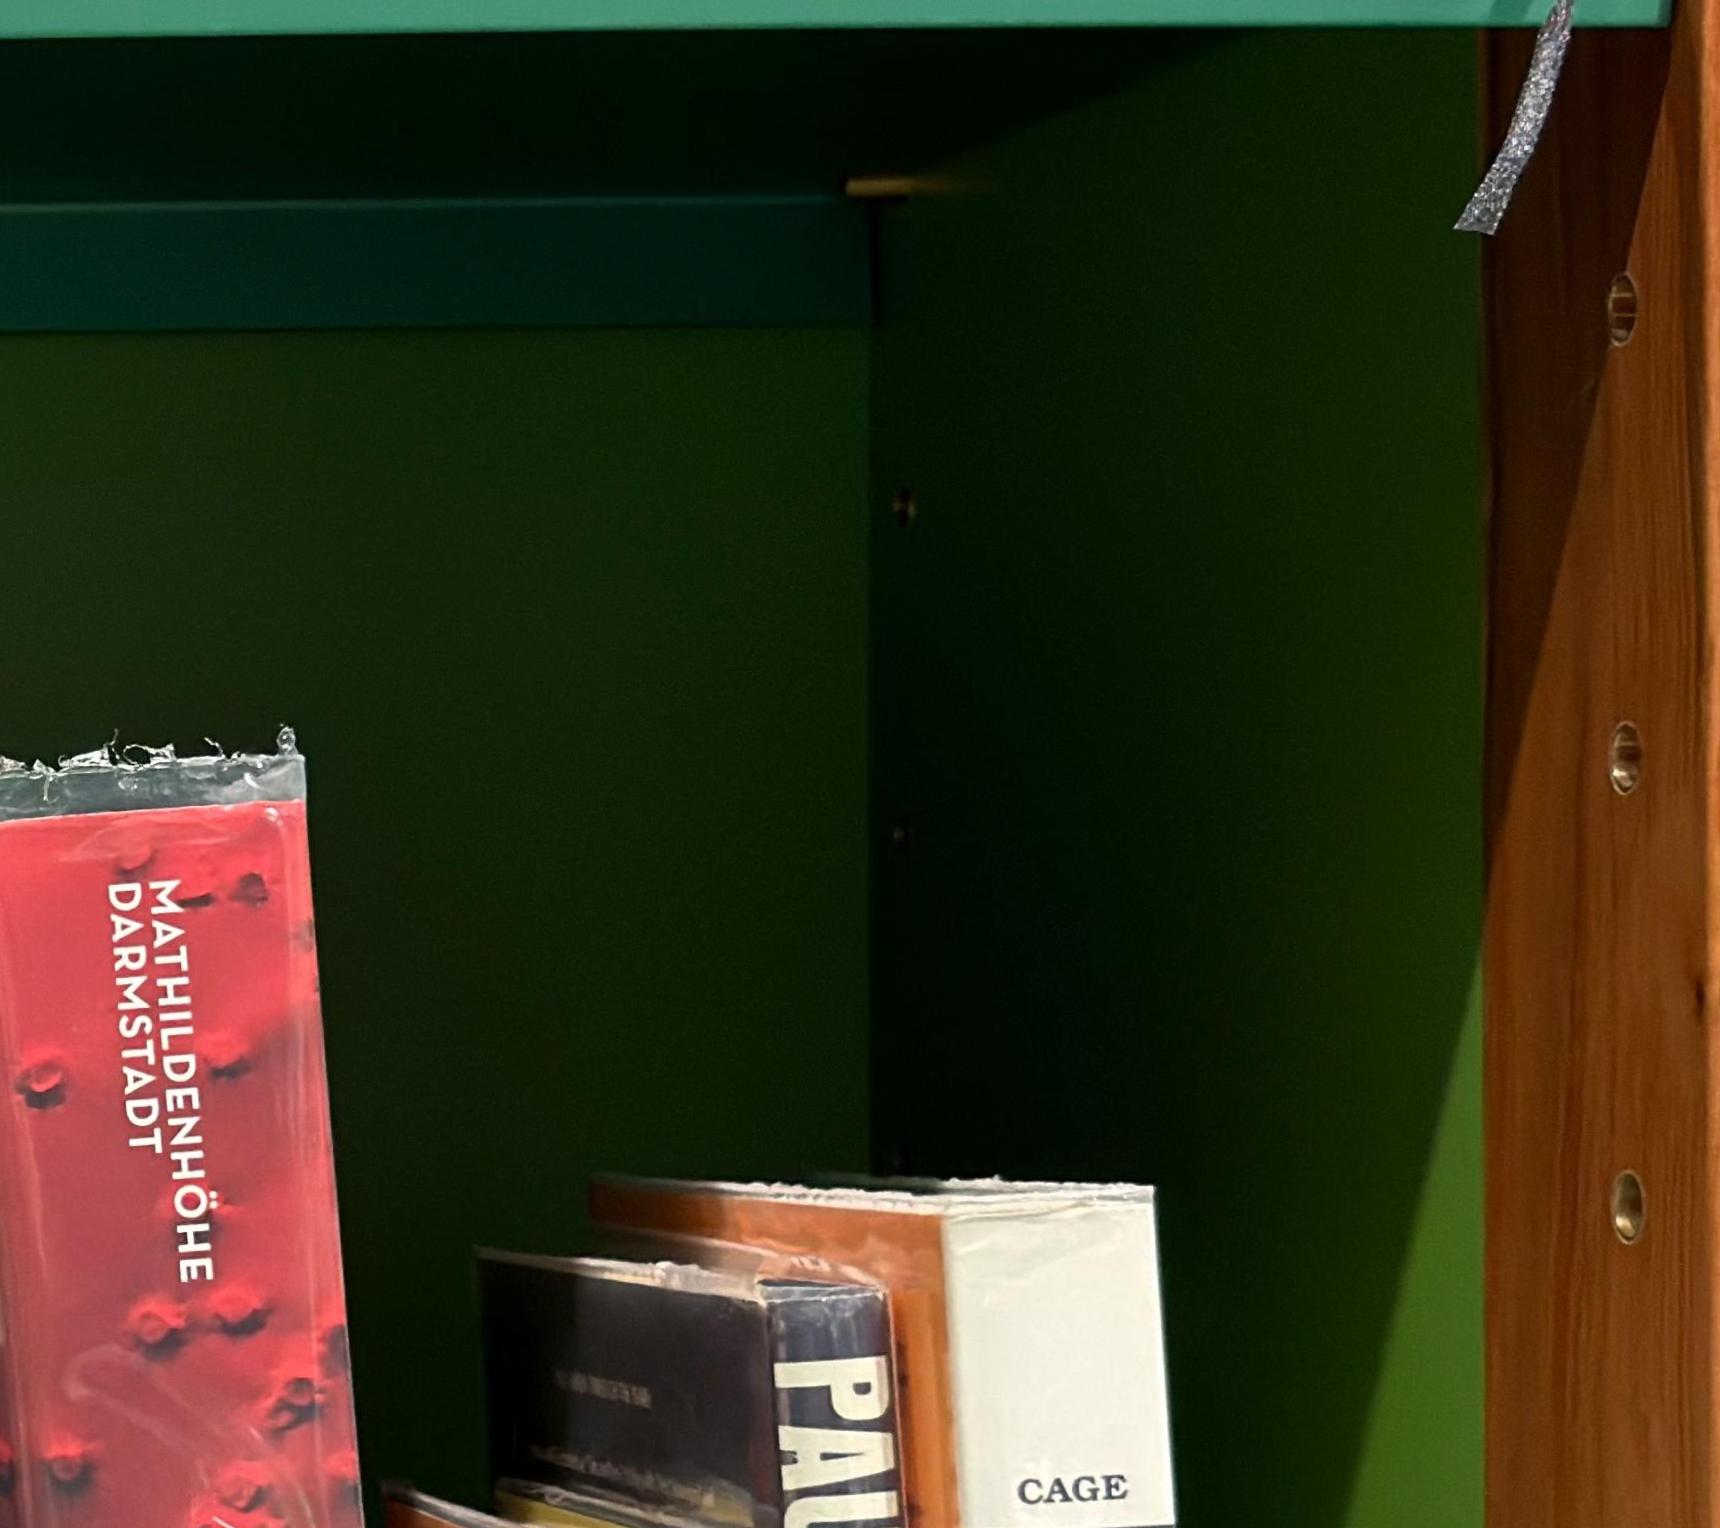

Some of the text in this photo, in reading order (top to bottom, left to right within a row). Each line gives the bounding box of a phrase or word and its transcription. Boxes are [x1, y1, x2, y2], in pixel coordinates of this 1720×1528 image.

[108, 882, 163, 1154] DARMSTADT
[149, 879, 218, 1282] MATHILDENHÖHE
[1016, 1474, 1129, 1507] CAGE
